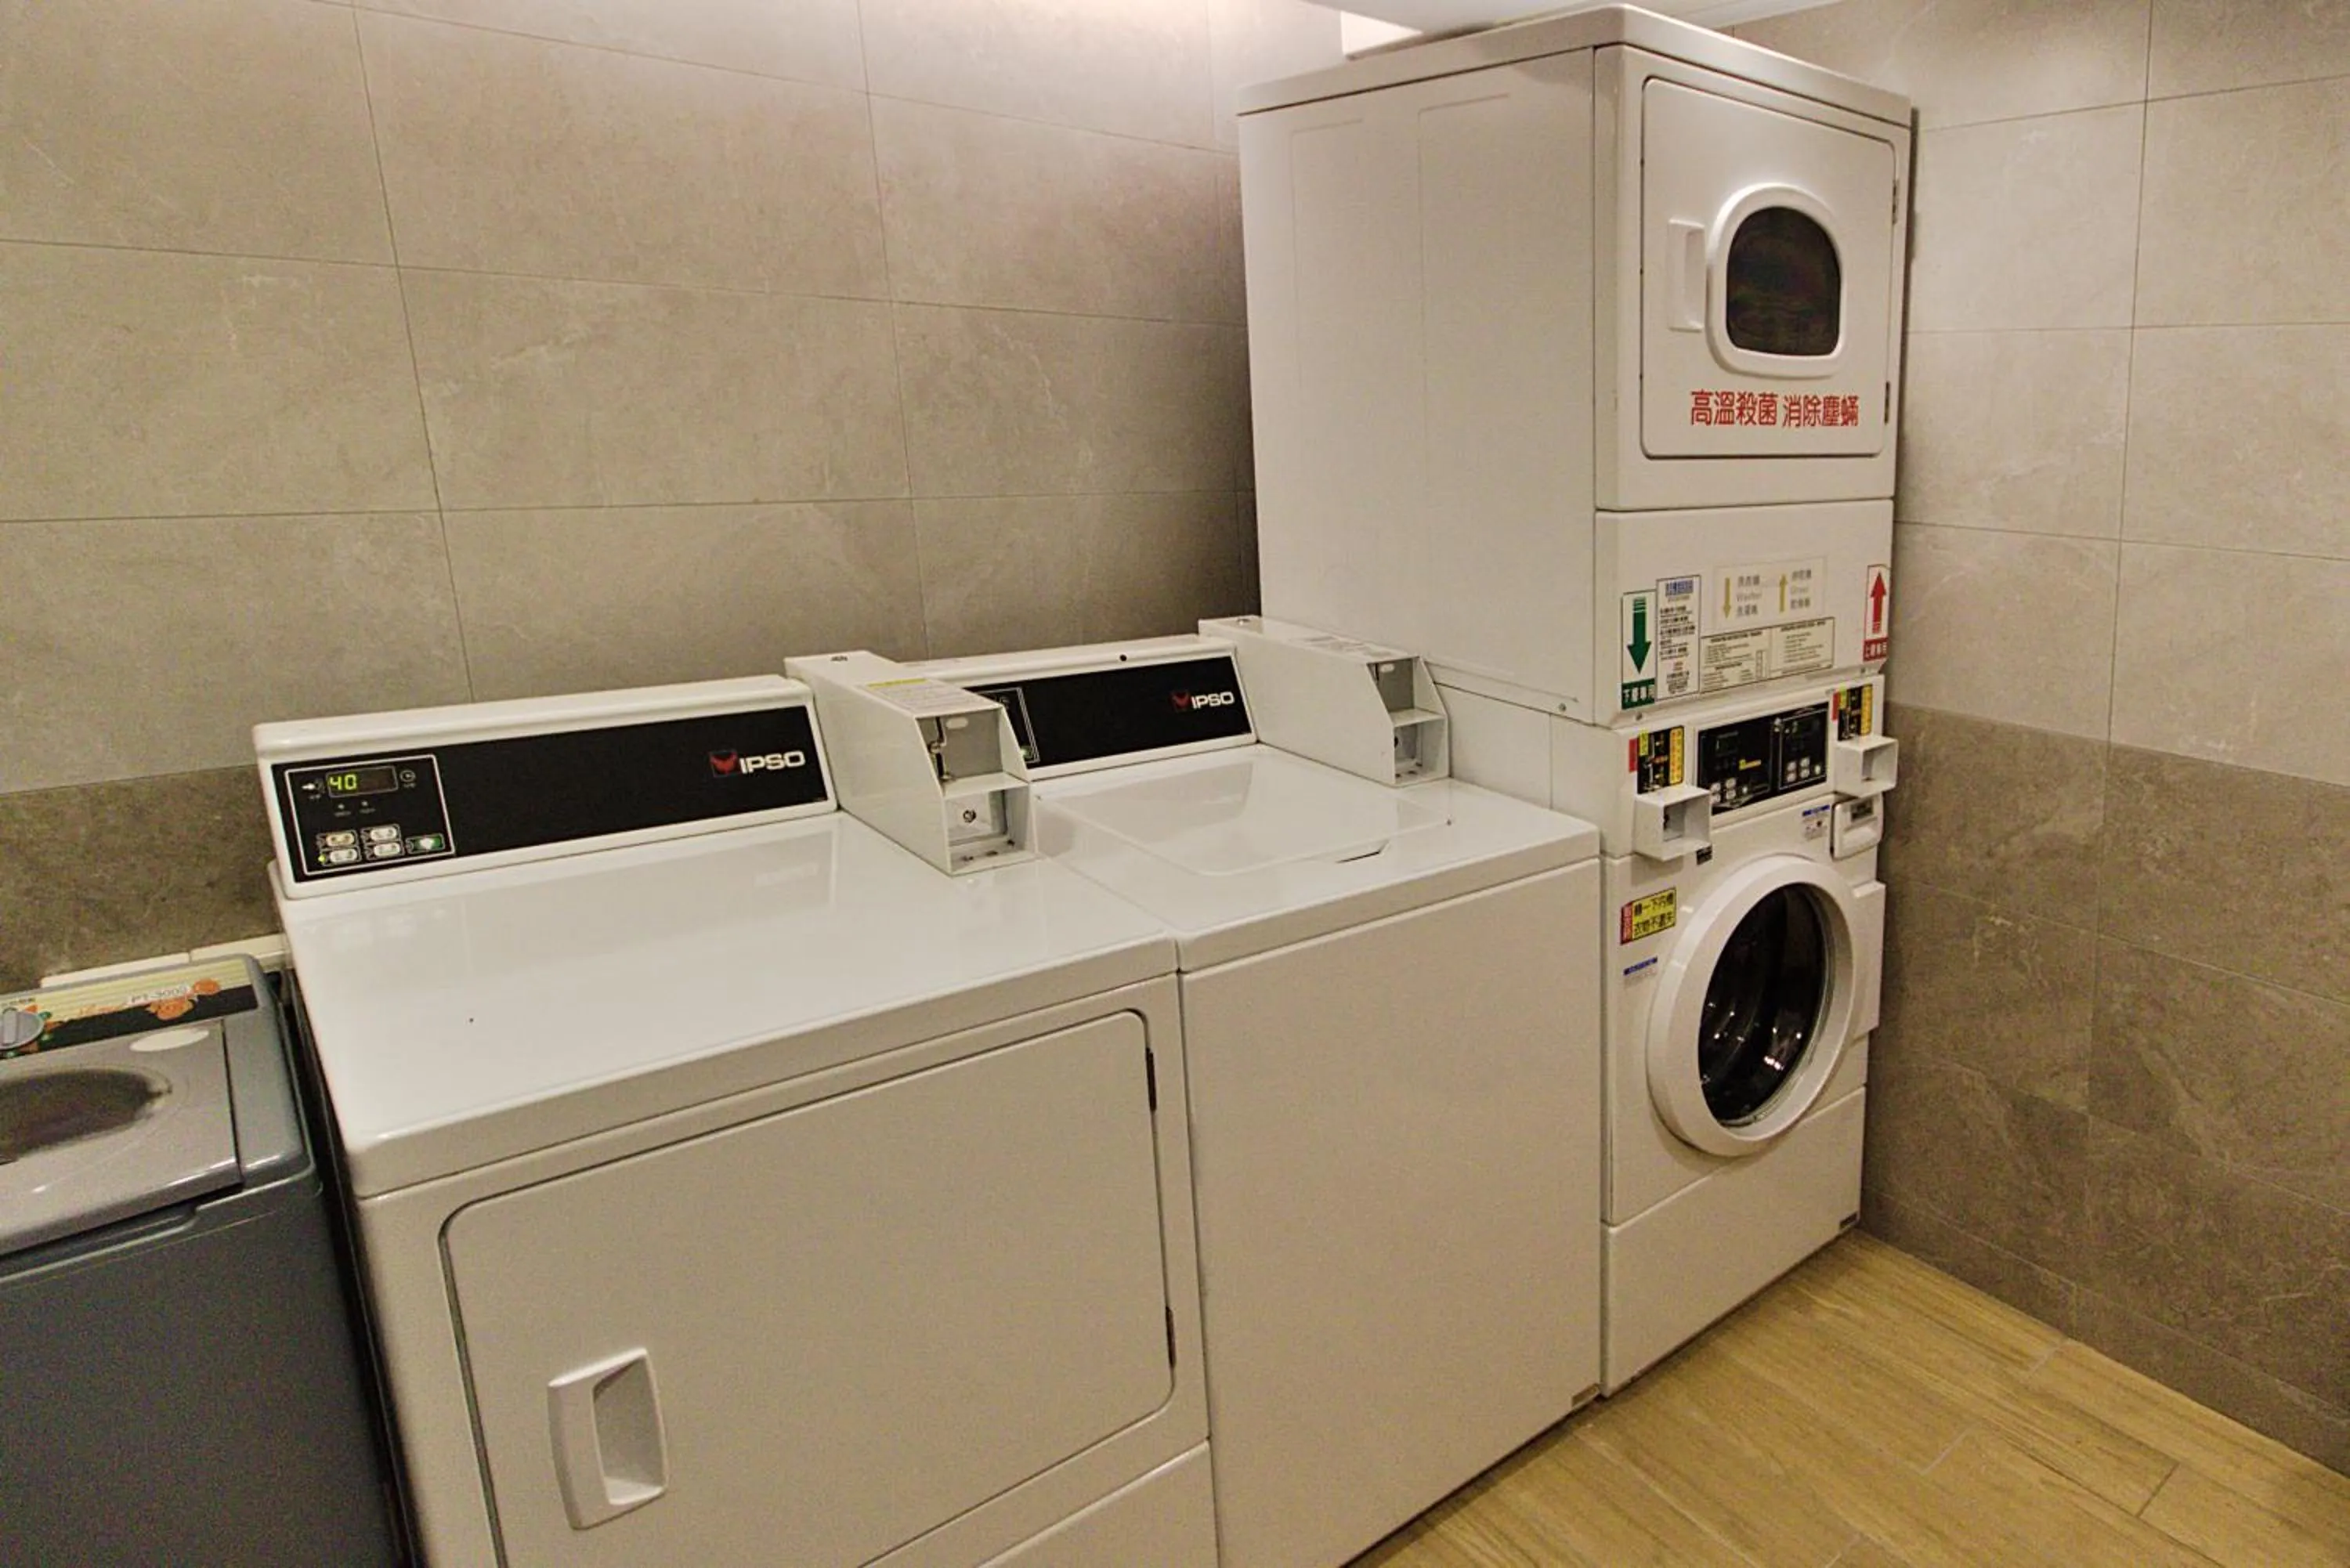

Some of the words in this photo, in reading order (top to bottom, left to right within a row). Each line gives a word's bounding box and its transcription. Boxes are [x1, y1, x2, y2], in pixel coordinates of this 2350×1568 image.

[1690, 389, 1778, 425] 高溫殺菌
[1191, 691, 1235, 709] IPSO
[739, 750, 805, 774] IPSO
[328, 774, 356, 791] 40
